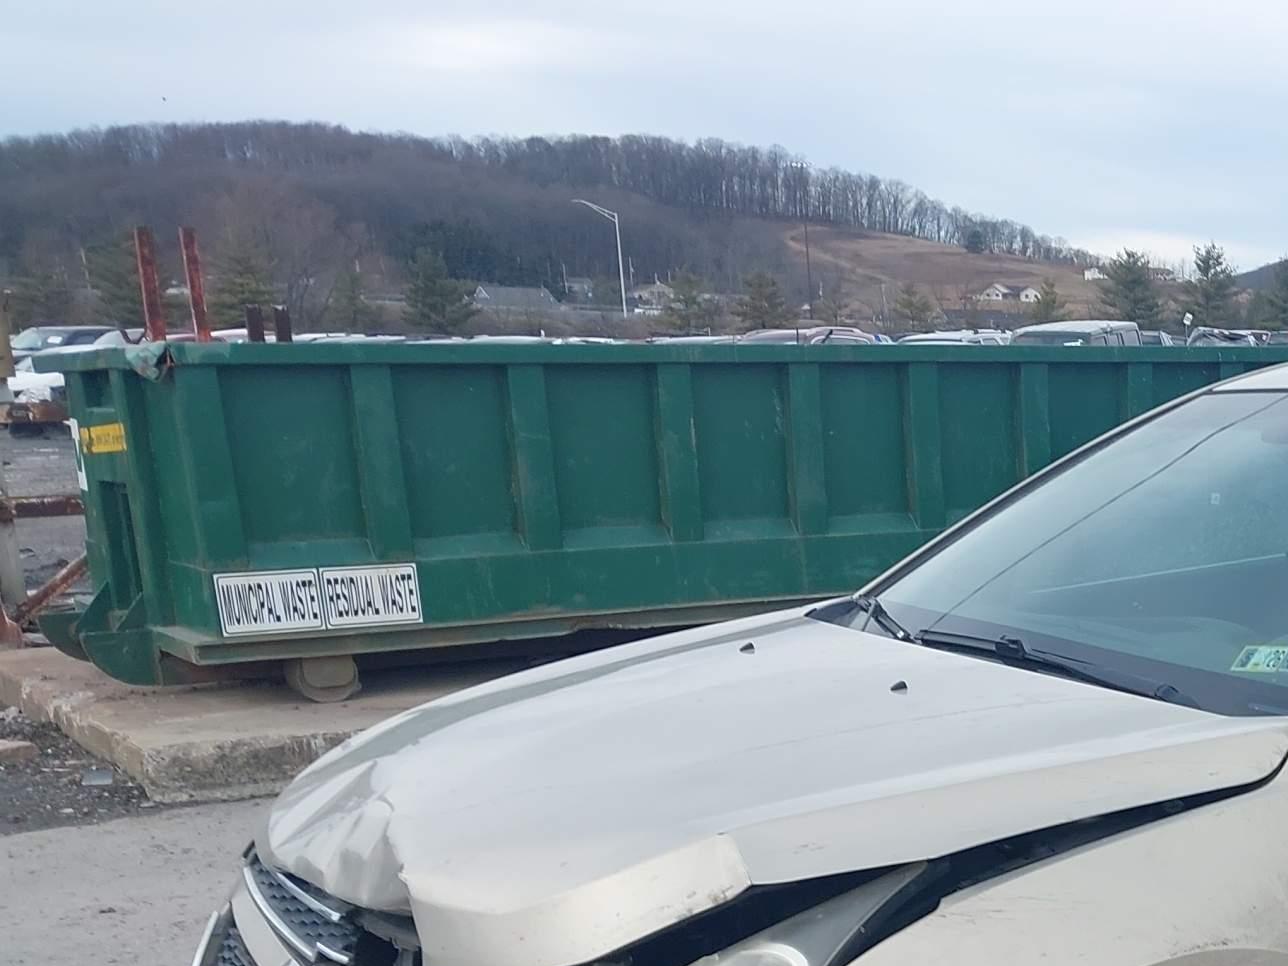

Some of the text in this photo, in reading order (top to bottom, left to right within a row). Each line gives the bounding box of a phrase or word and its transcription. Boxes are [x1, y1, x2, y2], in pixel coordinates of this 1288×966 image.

[221, 578, 319, 626] MUNICIPAL WASTE
[325, 573, 417, 618] RESIDUAL WASTE
